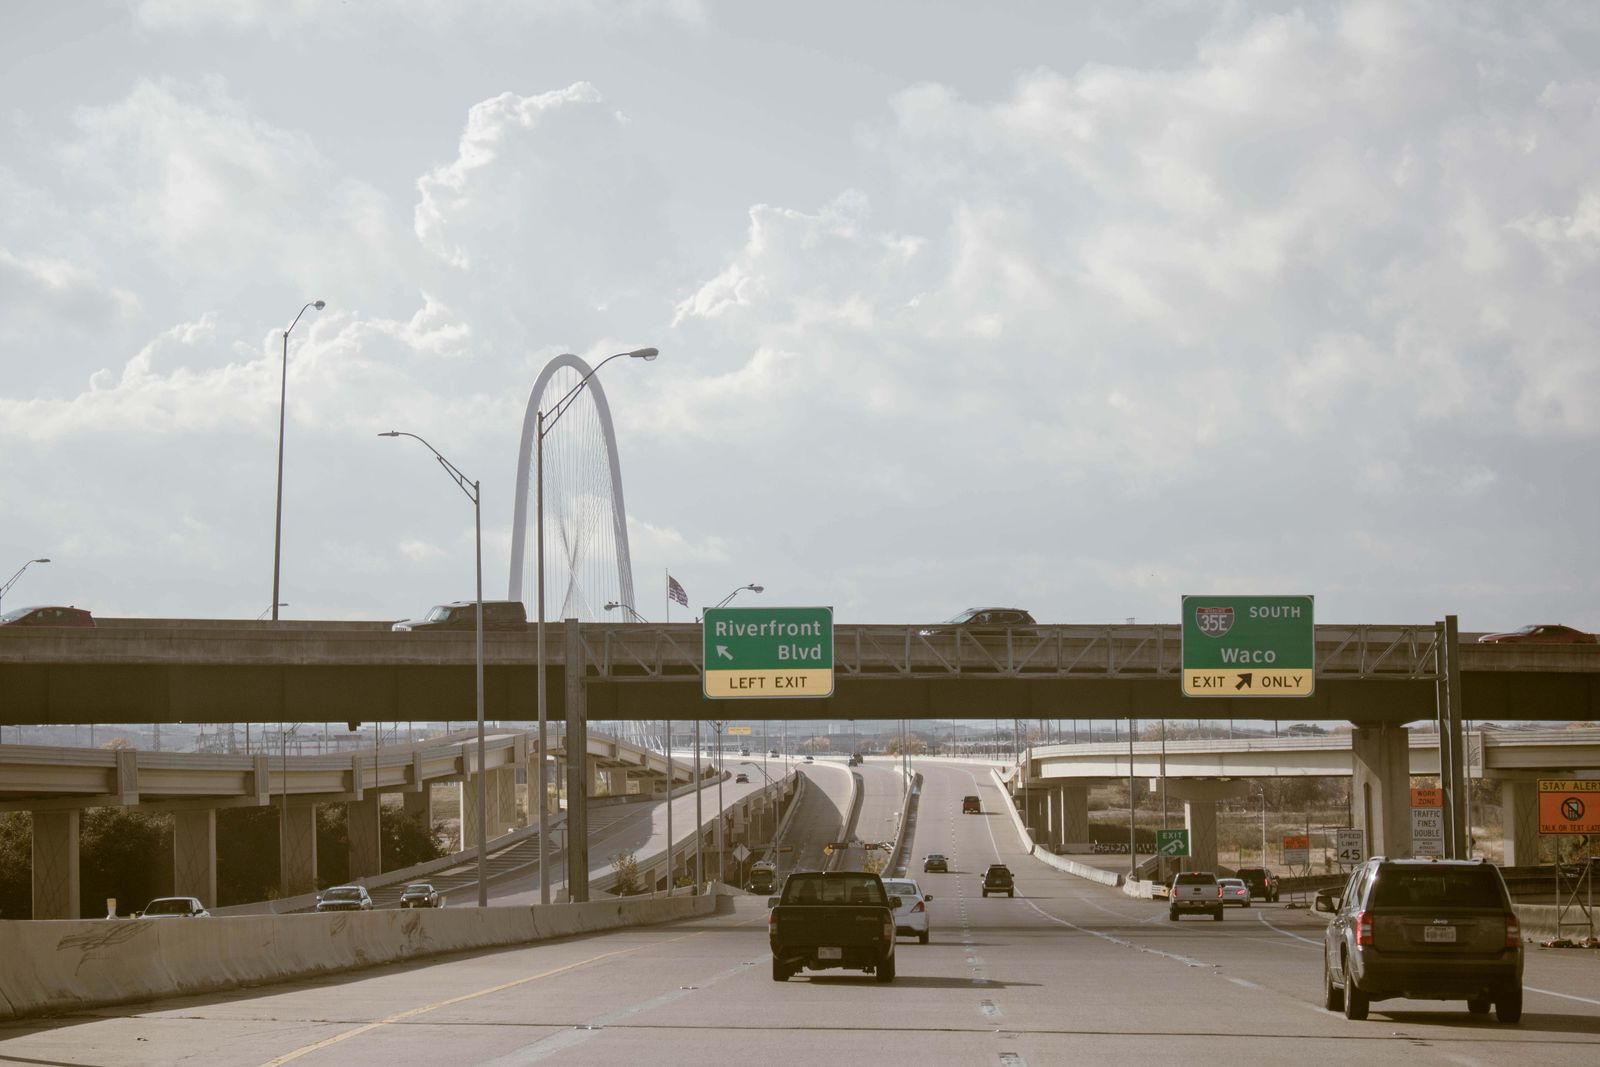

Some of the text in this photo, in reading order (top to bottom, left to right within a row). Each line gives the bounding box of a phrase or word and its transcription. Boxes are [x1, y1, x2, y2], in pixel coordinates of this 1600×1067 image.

[1200, 606, 1301, 631] 35E SOUTH
[715, 620, 821, 636] Riverfront
[778, 644, 822, 660] Blvd
[1221, 647, 1276, 663] Waco
[729, 676, 808, 689] LEFT EXIT
[1192, 676, 1303, 688] EXIT ONLY
[1542, 782, 1567, 790] STAY
[1413, 810, 1441, 818] TRAFFIC
[1417, 820, 1437, 828] FINES
[1340, 849, 1360, 861] 45
